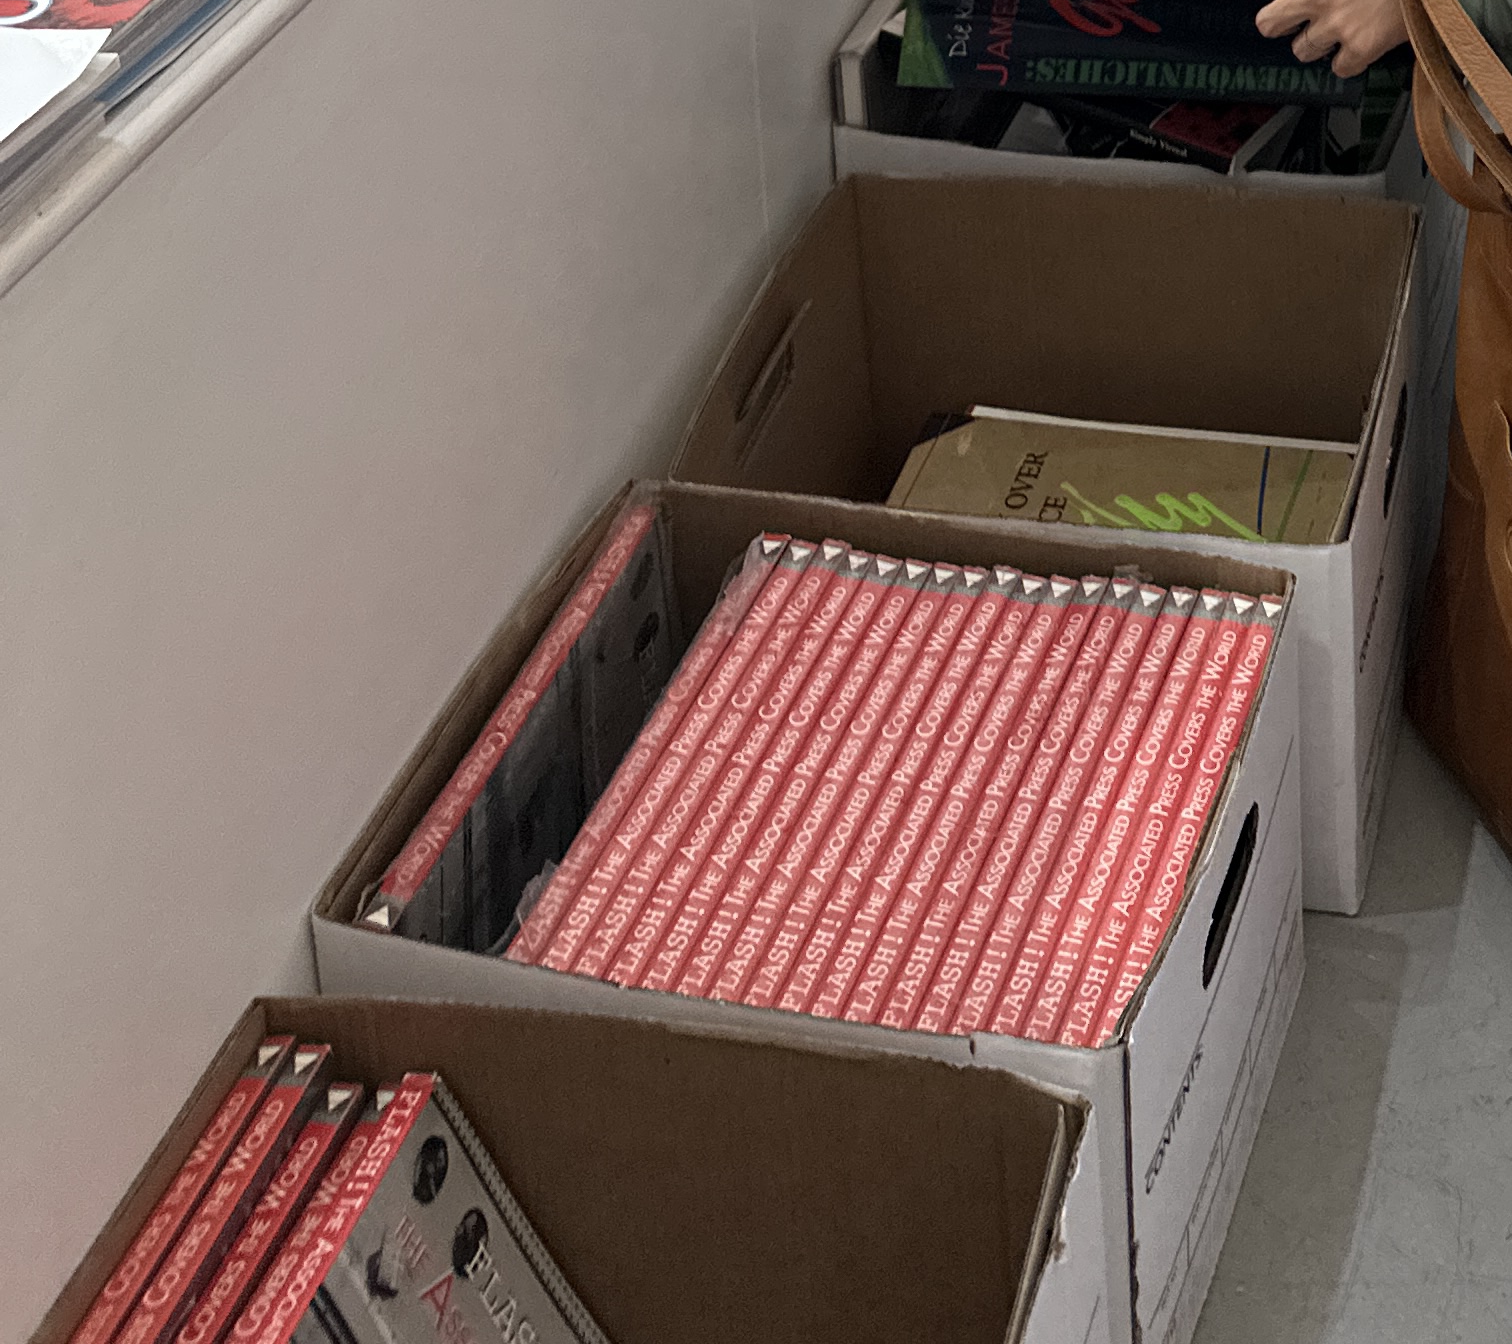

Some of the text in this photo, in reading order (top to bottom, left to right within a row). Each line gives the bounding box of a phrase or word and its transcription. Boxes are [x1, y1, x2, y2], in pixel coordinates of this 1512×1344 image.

[948, 20, 971, 58] Die
[1025, 55, 1346, 97] UNGEWÖHNLICHES:
[1004, 451, 1048, 510] OVER
[778, 575, 821, 623] WORLD
[834, 591, 875, 640] WORLD
[768, 627, 793, 652] THE
[956, 601, 996, 651] WORLD
[984, 610, 1023, 659] WORLD
[1047, 612, 1088, 663] WORLD
[1076, 614, 1115, 666] WORLD
[822, 643, 848, 668] THE
[947, 653, 971, 678] THE
[974, 663, 998, 687] THE
[1037, 666, 1061, 690] THE
[1200, 629, 1236, 680] WORLD
[730, 653, 776, 709] COVERS
[788, 670, 832, 727] COVERS
[1068, 669, 1092, 693] THE
[1194, 682, 1216, 708] THE
[703, 712, 743, 755] PRESS
[915, 681, 957, 738] COVERS
[942, 690, 985, 747] COVERS
[1006, 692, 1048, 751] COVERS
[1039, 696, 1079, 754] COVERS
[761, 729, 800, 772] PRESS
[891, 740, 928, 784] PRESS
[1166, 711, 1206, 769] COVERS
[919, 750, 956, 793] PRESS
[985, 753, 1020, 797] PRESS
[1017, 756, 1054, 800] PRESS
[1147, 772, 1182, 816] PRESS
[652, 757, 716, 849] ASSOCIATED
[711, 776, 774, 869] ASSOCIATED
[846, 787, 904, 881] ASSOCIATED
[875, 797, 933, 890] ASSOCIATED
[942, 800, 998, 895] ASSOCIATED
[977, 803, 1032, 899] ASSOCIATED
[628, 850, 662, 880] THE
[689, 870, 723, 901] THE
[1111, 820, 1163, 916] ASSOCIATED
[824, 881, 858, 913] THE
[854, 893, 887, 923] THE
[922, 898, 955, 928] THE
[957, 901, 990, 932] THE
[1094, 918, 1126, 949] THE
[184, 1092, 247, 1168] WORLD
[222, 1099, 285, 1177] WORLD
[347, 1088, 423, 1193] FLASH!
[254, 1137, 318, 1215] WORLD
[308, 1135, 368, 1209] WORLD
